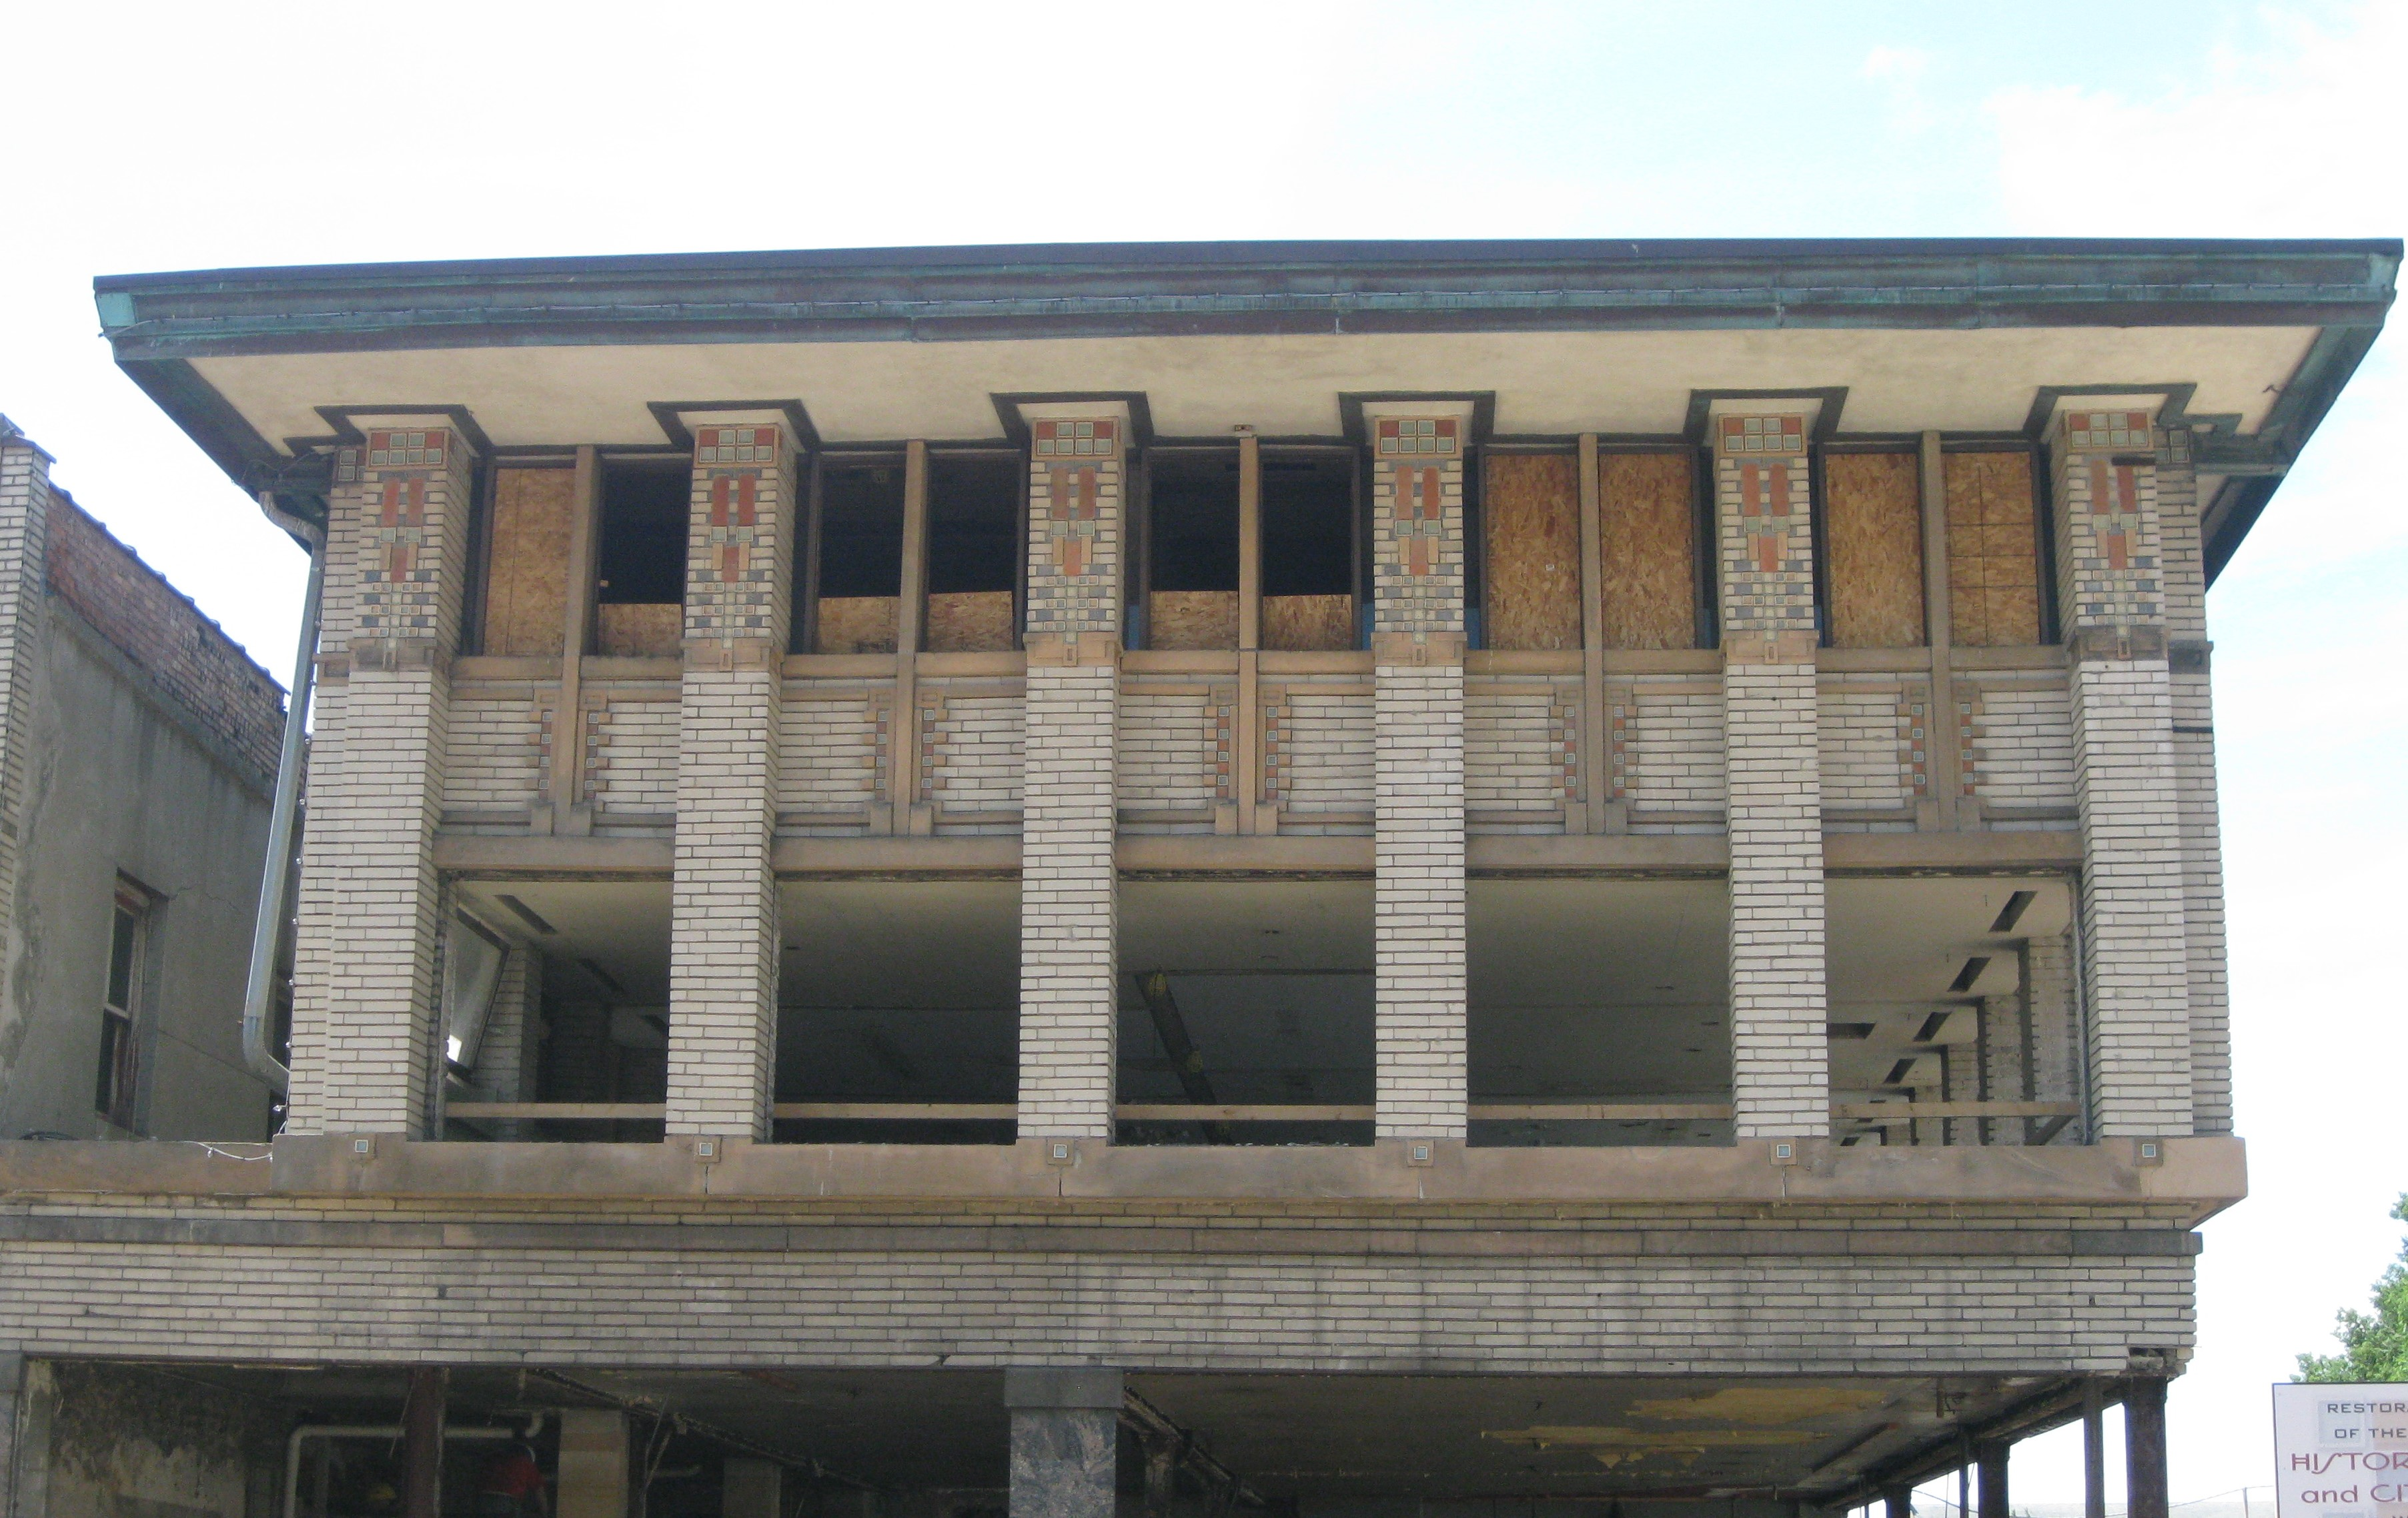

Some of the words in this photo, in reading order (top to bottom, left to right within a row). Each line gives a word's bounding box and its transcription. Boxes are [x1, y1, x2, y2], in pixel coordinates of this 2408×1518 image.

[2327, 1403, 2408, 1413] RESTOR
[2335, 1429, 2359, 1439] OF
[2369, 1427, 2407, 1438] THE
[2301, 1485, 2358, 1503] and
[2370, 1484, 2408, 1503] CI
